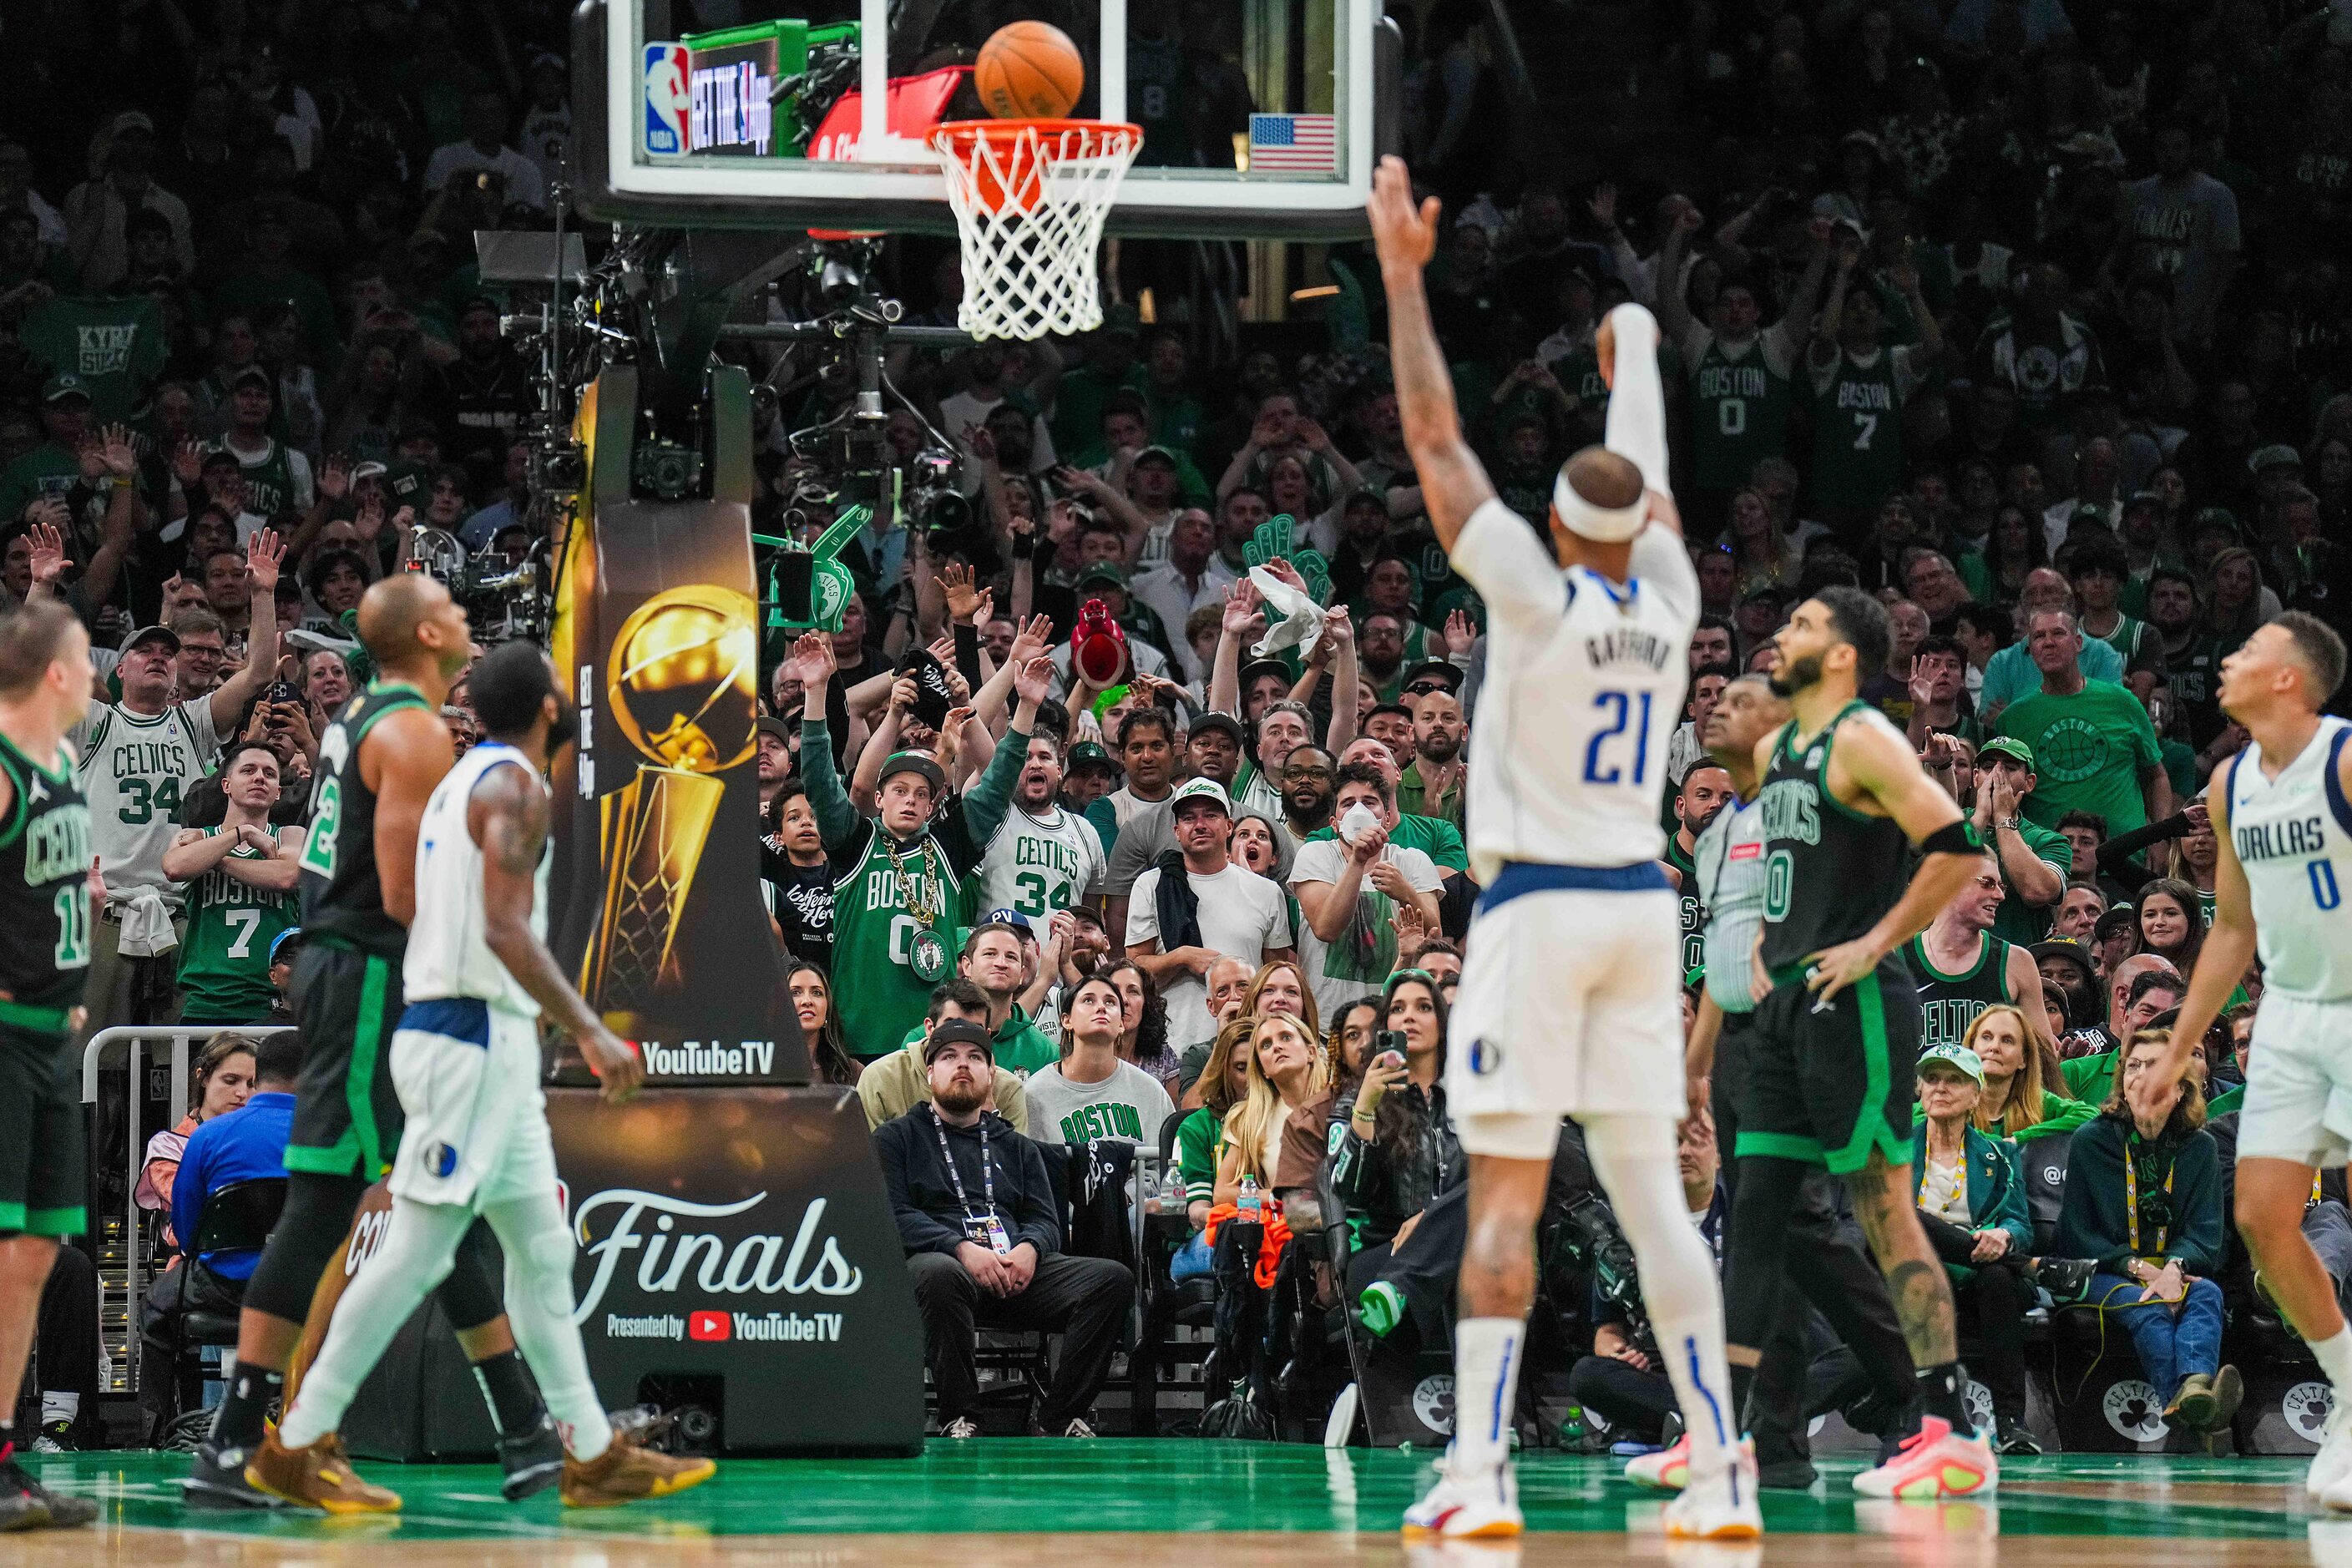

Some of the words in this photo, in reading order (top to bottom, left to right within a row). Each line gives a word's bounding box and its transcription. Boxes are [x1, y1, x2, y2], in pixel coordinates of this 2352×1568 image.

[1700, 364, 1768, 400] BOSTON
[1838, 380, 1892, 411] BOSTON
[1718, 397, 1746, 436] 0
[1853, 412, 1877, 450] 7
[817, 574, 838, 598] TICS
[1584, 690, 1652, 785] 21
[2043, 718, 2096, 740] BOSTON
[114, 741, 185, 779] CELTICS
[119, 776, 181, 825] 34
[2238, 815, 2324, 862] DALLAS
[1016, 836, 1078, 881] CELTICS
[1014, 871, 1070, 918] 34
[1762, 849, 1794, 923] 0
[2306, 857, 2341, 911] 0
[225, 908, 260, 959] 7
[1044, 1028, 1058, 1038] RINT
[1060, 1101, 1145, 1144] BOSTON
[574, 1188, 863, 1327] Finals
[606, 1313, 669, 1338] Presented
[668, 1313, 686, 1342] by
[1417, 1378, 1454, 1403] CELT
[2107, 1383, 2161, 1409] CELTICS
[2287, 1385, 2334, 1411] CELTIC
